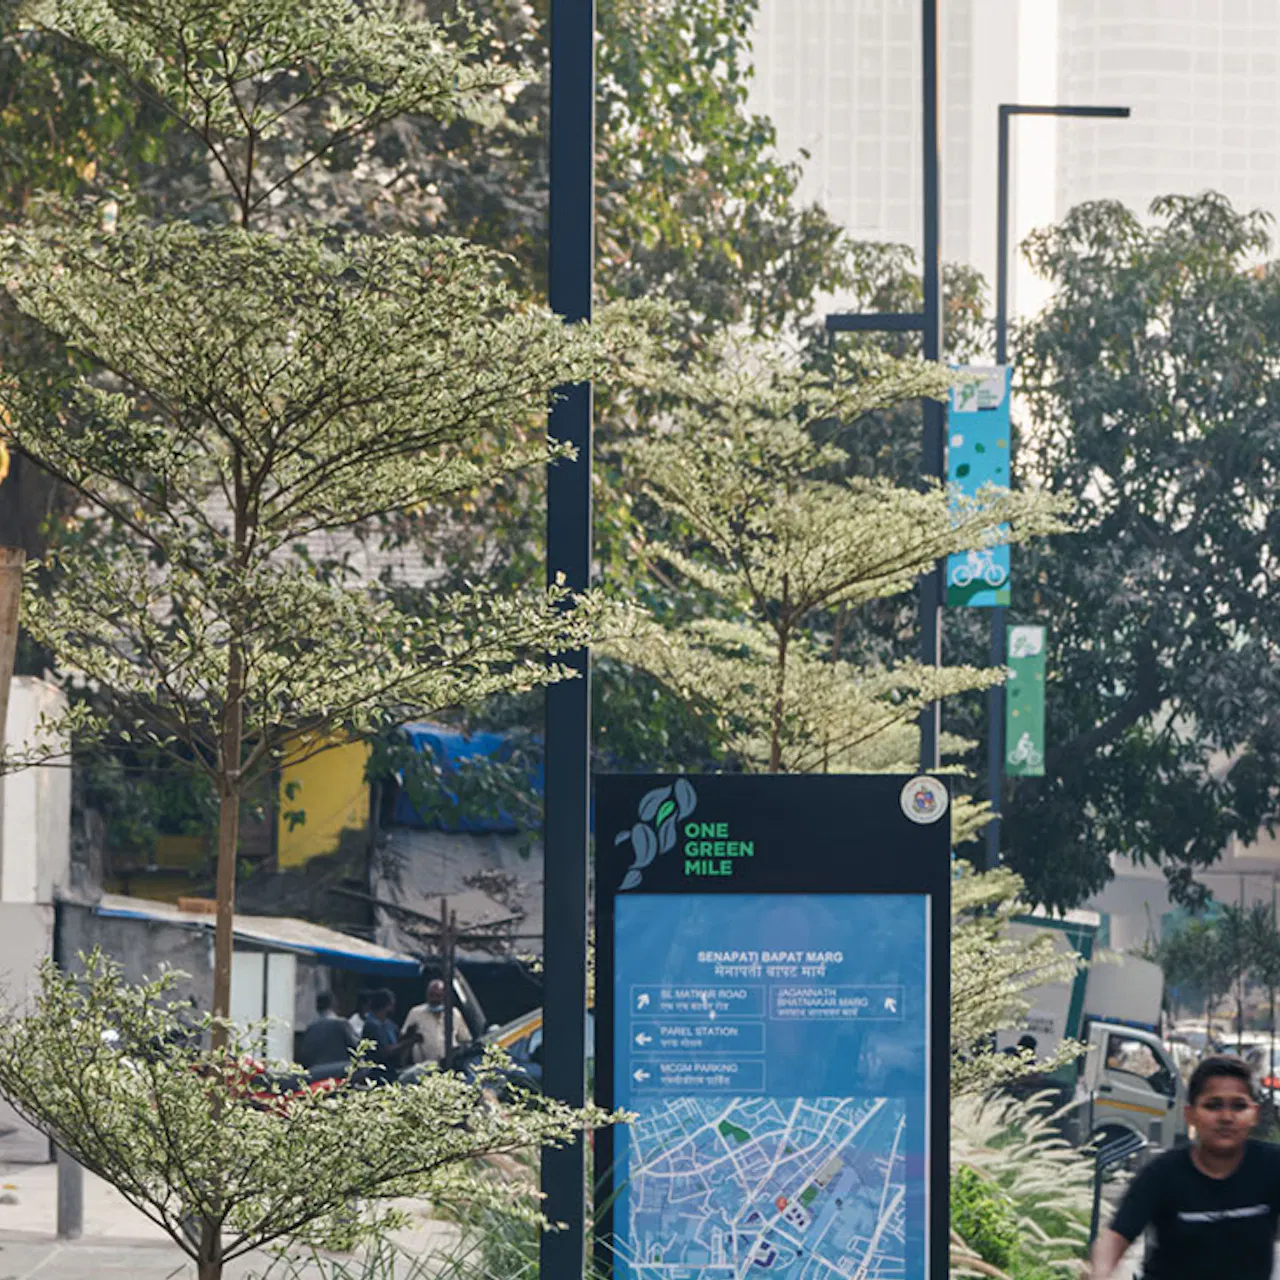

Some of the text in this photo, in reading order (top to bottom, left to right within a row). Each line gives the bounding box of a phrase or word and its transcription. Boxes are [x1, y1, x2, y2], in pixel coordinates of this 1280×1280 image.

[684, 822, 729, 838] ONE
[684, 840, 754, 857] GREEN
[684, 859, 733, 876] MILE
[697, 951, 844, 963] SENAPATI BAPAT MARG
[695, 1026, 738, 1037] STATION
